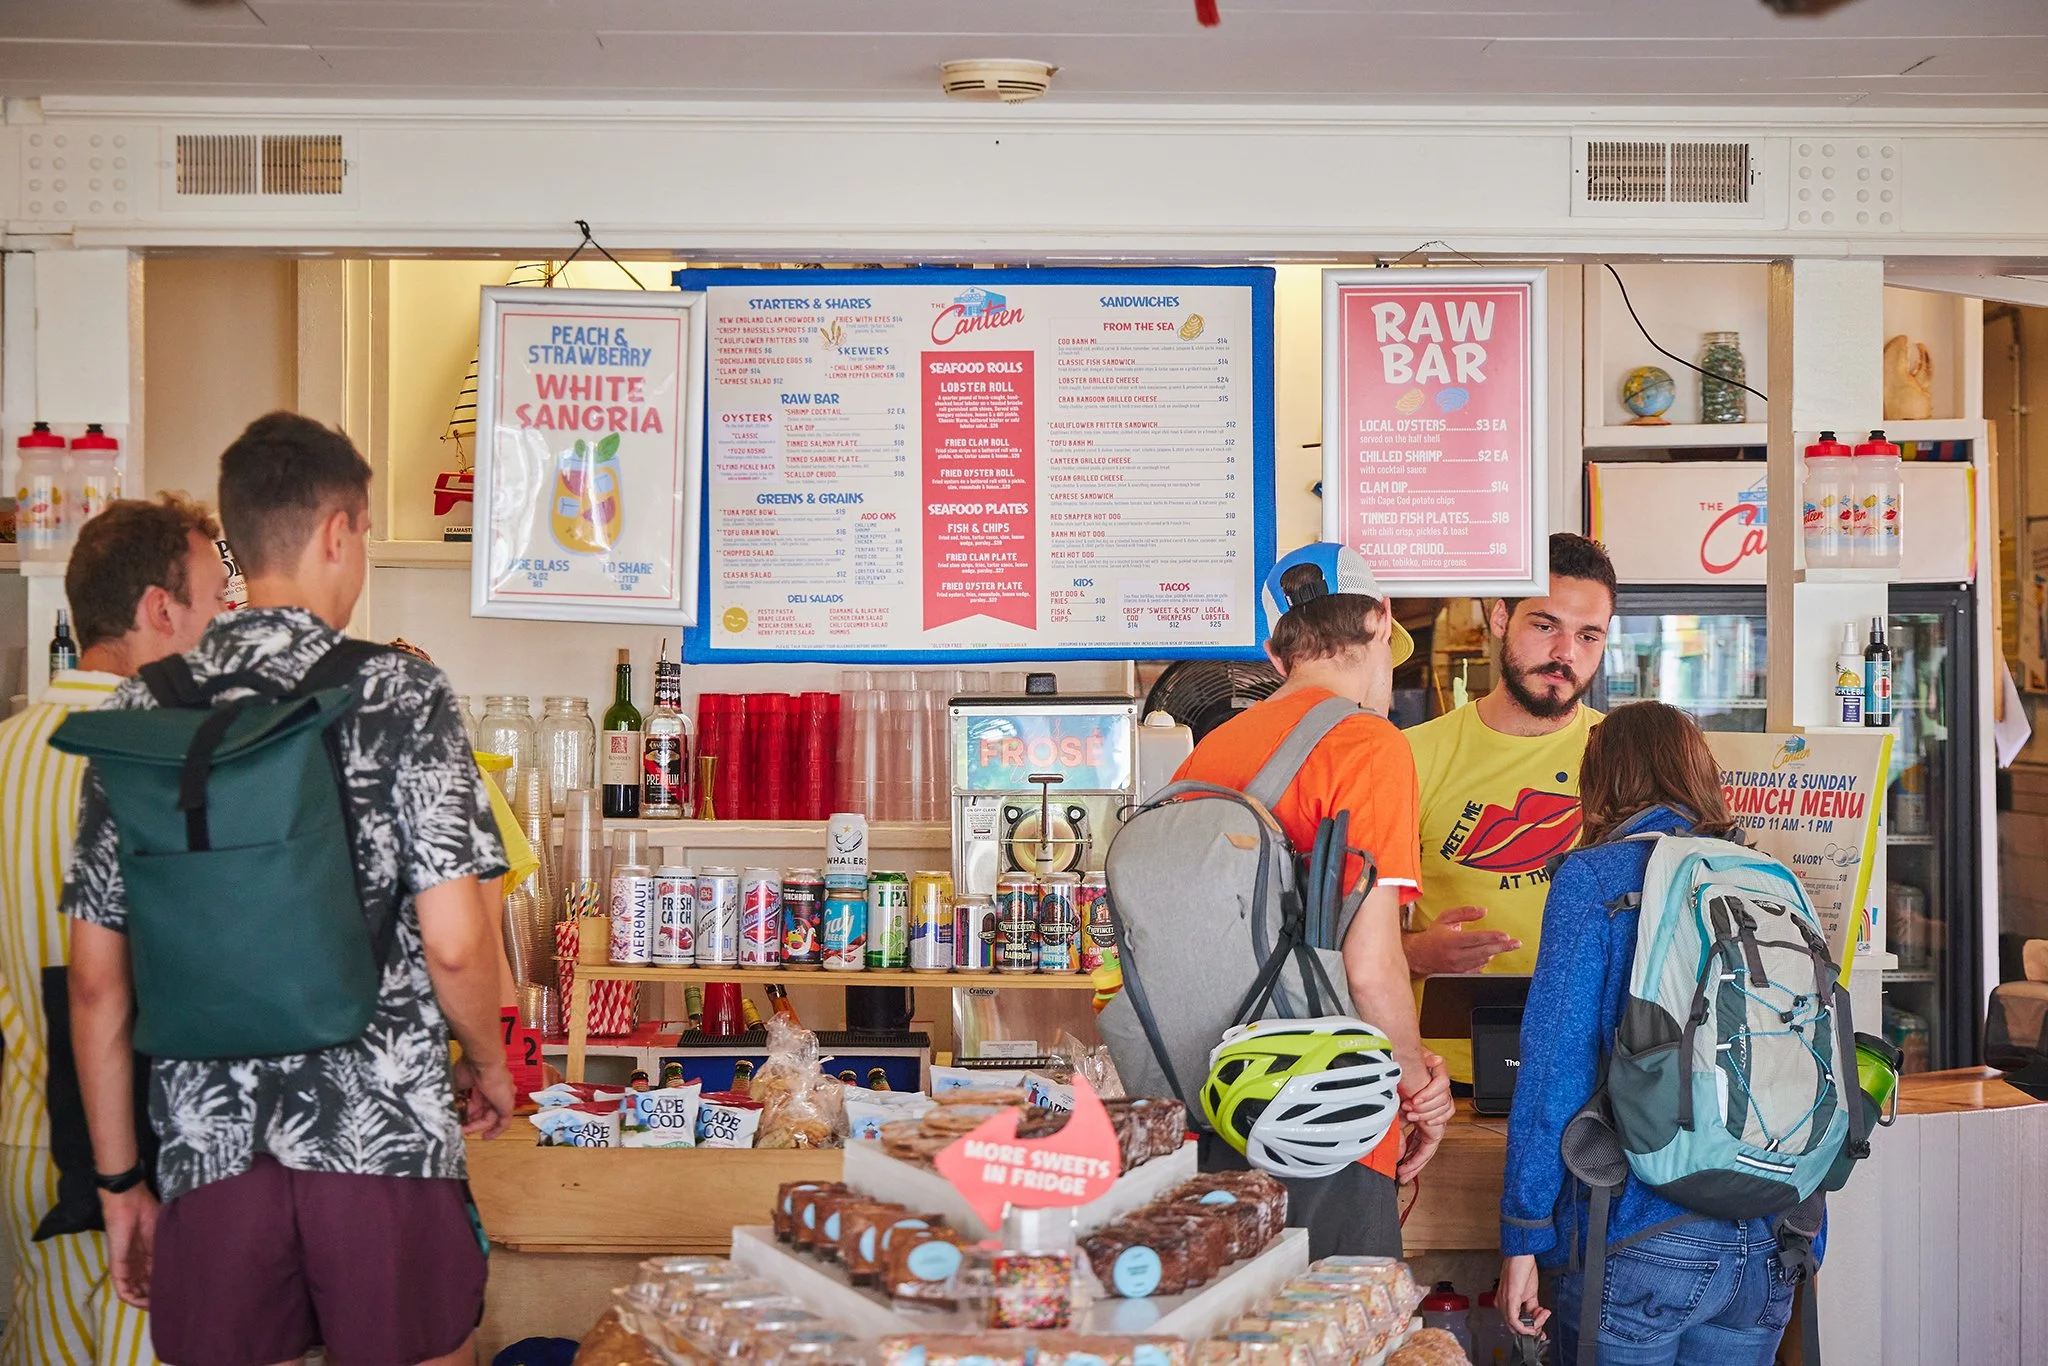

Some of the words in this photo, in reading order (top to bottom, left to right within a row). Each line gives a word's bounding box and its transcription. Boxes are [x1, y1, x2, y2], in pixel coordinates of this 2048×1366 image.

[749, 299, 810, 310] STARTERS
[813, 299, 822, 309] &
[825, 298, 872, 310] SHARES
[1100, 296, 1180, 308] SANDWICHES
[931, 300, 1024, 345] Canteen
[1103, 322, 1131, 331] FROM
[1136, 322, 1153, 331] THE
[1156, 322, 1174, 331] SEA
[1371, 301, 1495, 343] RAW
[552, 326, 609, 347] PEACH
[614, 328, 630, 347] &
[528, 345, 652, 367] STRAWBERRY
[838, 348, 890, 356] SKEWERS
[929, 362, 985, 374] SEAFOOD
[987, 362, 1023, 374] ROLLS
[1380, 343, 1487, 385] BAR
[535, 374, 645, 402] WHITE
[941, 382, 986, 392] LOBSTER
[989, 382, 1014, 392] ROLL
[781, 394, 810, 405] RAW
[814, 393, 840, 404] BAR
[515, 403, 663, 434] SANGRIA
[722, 413, 772, 424] OYSTERS
[1359, 420, 1394, 432] LOCAL
[1396, 420, 1446, 432] OYSTERS
[1476, 420, 1490, 432] $3
[1492, 420, 1507, 432] EA
[1359, 434, 1383, 444] served
[1384, 436, 1393, 444] on
[1394, 434, 1406, 444] the
[1408, 433, 1422, 443] half
[1424, 433, 1440, 443] shell
[1359, 450, 1402, 463] CHILLED
[1405, 450, 1443, 463] SHRIMP
[1478, 450, 1491, 463] $2
[1494, 450, 1508, 463] EA
[940, 469, 962, 477] FRIED
[964, 469, 994, 477] OYSTER
[996, 469, 1014, 477] ROLL
[1360, 465, 1374, 474] with
[1377, 465, 1404, 474] cocktail
[1406, 466, 1426, 474] sauce
[1360, 482, 1389, 494] CLAM
[1392, 482, 1408, 494] DIP
[1491, 481, 1509, 494] $14
[756, 493, 804, 504] GREENS
[806, 493, 816, 504] &
[819, 493, 864, 504] GRAINS
[1360, 496, 1375, 506] with
[1377, 496, 1395, 508] Cape
[1396, 496, 1410, 506] Cod
[1412, 496, 1434, 508] potato
[1436, 496, 1455, 507] chips
[928, 503, 983, 516] SEAFOOD
[985, 503, 1029, 515] PLATES
[1699, 502, 1724, 512] THE
[860, 512, 878, 520] ADD
[880, 512, 896, 520] ONS
[1360, 512, 1398, 524] TINNED
[1400, 512, 1424, 524] FISH
[1426, 512, 1470, 524] PLATES
[1492, 512, 1510, 524] $18
[948, 523, 968, 533] FISH
[972, 523, 980, 533] &
[983, 523, 1010, 533] CHIPS
[1362, 527, 1376, 536] with
[1378, 526, 1394, 536] chili
[1395, 527, 1415, 538] crisp,
[1416, 527, 1441, 538] pickles
[1442, 527, 1449, 536] &
[1450, 527, 1468, 536] toast
[1700, 503, 1768, 575] Ca
[1359, 543, 1406, 556] SCALLOP
[1409, 543, 1444, 555] CRUDO
[1489, 542, 1507, 555] $18
[534, 560, 570, 572] GLASS
[618, 562, 654, 574] SHARE
[1444, 559, 1467, 568] greens
[1073, 578, 1094, 588] KIDS
[1159, 582, 1190, 592] TACOS
[788, 594, 807, 603] DELI
[809, 594, 844, 603] SALADS
[979, 728, 1105, 768] FROSÉ
[1772, 746, 1810, 770] Canteen
[1719, 771, 1786, 788] SATURDAY
[1788, 773, 1798, 789] &
[1800, 774, 1857, 791] SUNDAY
[1720, 786, 1796, 816] RUNCH
[1800, 790, 1866, 819] MENU
[1461, 800, 1484, 822] ME
[1733, 816, 1766, 830] ERVED
[1768, 817, 1781, 830] 11
[1782, 818, 1799, 831] AM
[1816, 820, 1833, 833] PM
[1439, 820, 1470, 861] MEET
[826, 857, 867, 866] WHALERS
[1792, 854, 1824, 866] SAVORY
[1499, 874, 1521, 890] AT
[1525, 866, 1552, 886] TH
[878, 891, 909, 908] IPA
[969, 988, 994, 996] Crathco
[501, 1016, 516, 1046] 7
[523, 1037, 538, 1066] 2
[641, 1098, 684, 1114] CAPE
[648, 1114, 686, 1130] COD
[702, 1108, 742, 1132] CAPE
[569, 1120, 610, 1139] CAPE
[704, 1123, 736, 1141] COD
[964, 1139, 1026, 1166] MORE
[1029, 1149, 1111, 1178] SWEETS
[983, 1163, 1006, 1185] IN
[1011, 1170, 1086, 1198] FRIDGE
